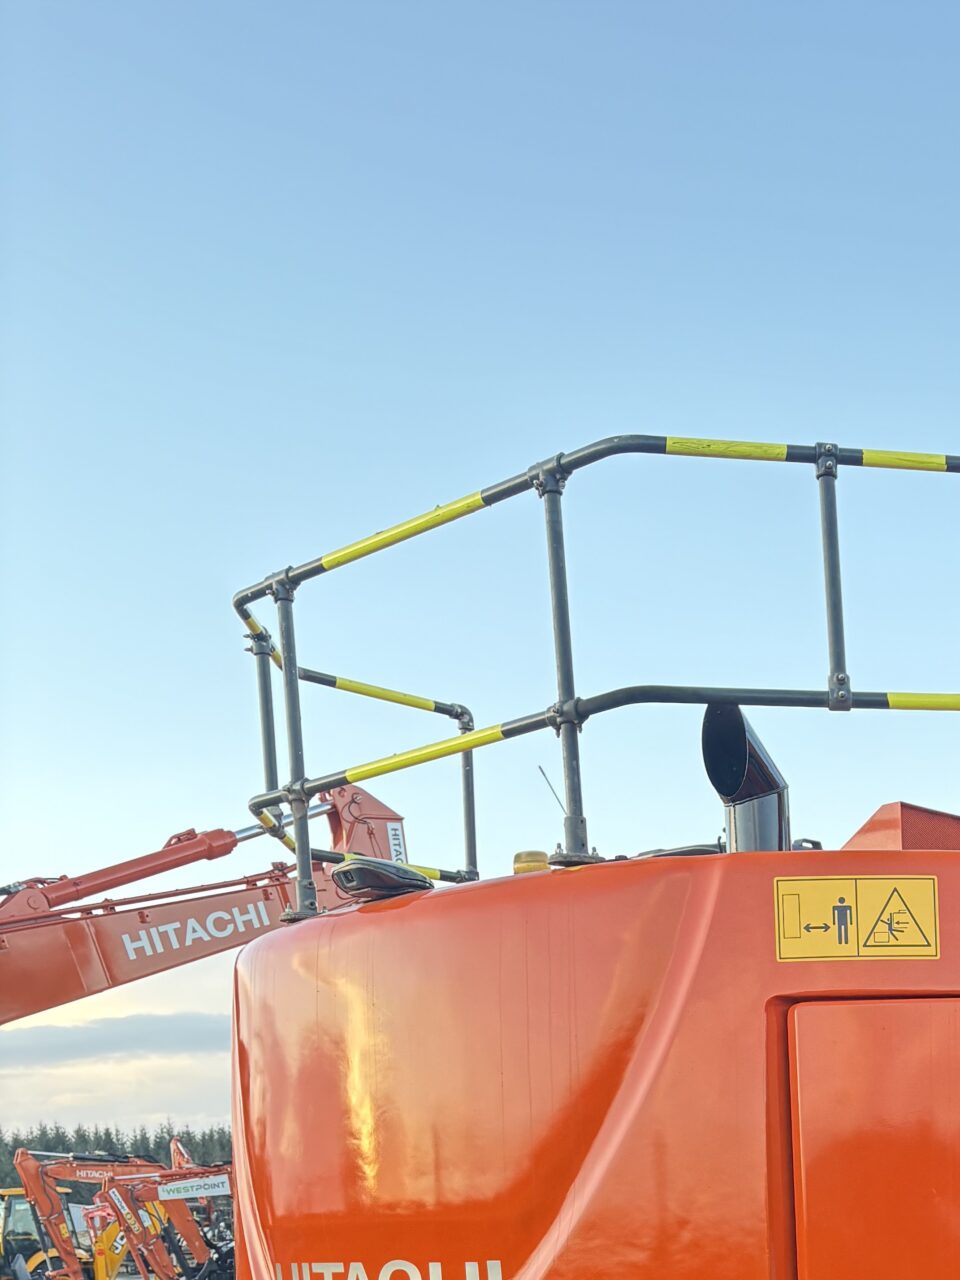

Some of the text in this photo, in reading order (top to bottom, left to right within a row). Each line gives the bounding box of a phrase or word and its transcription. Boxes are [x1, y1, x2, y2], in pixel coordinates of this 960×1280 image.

[121, 901, 271, 960] HITACHI
[76, 1169, 113, 1178] HITACHI
[165, 1181, 227, 1195] WESTPOINT
